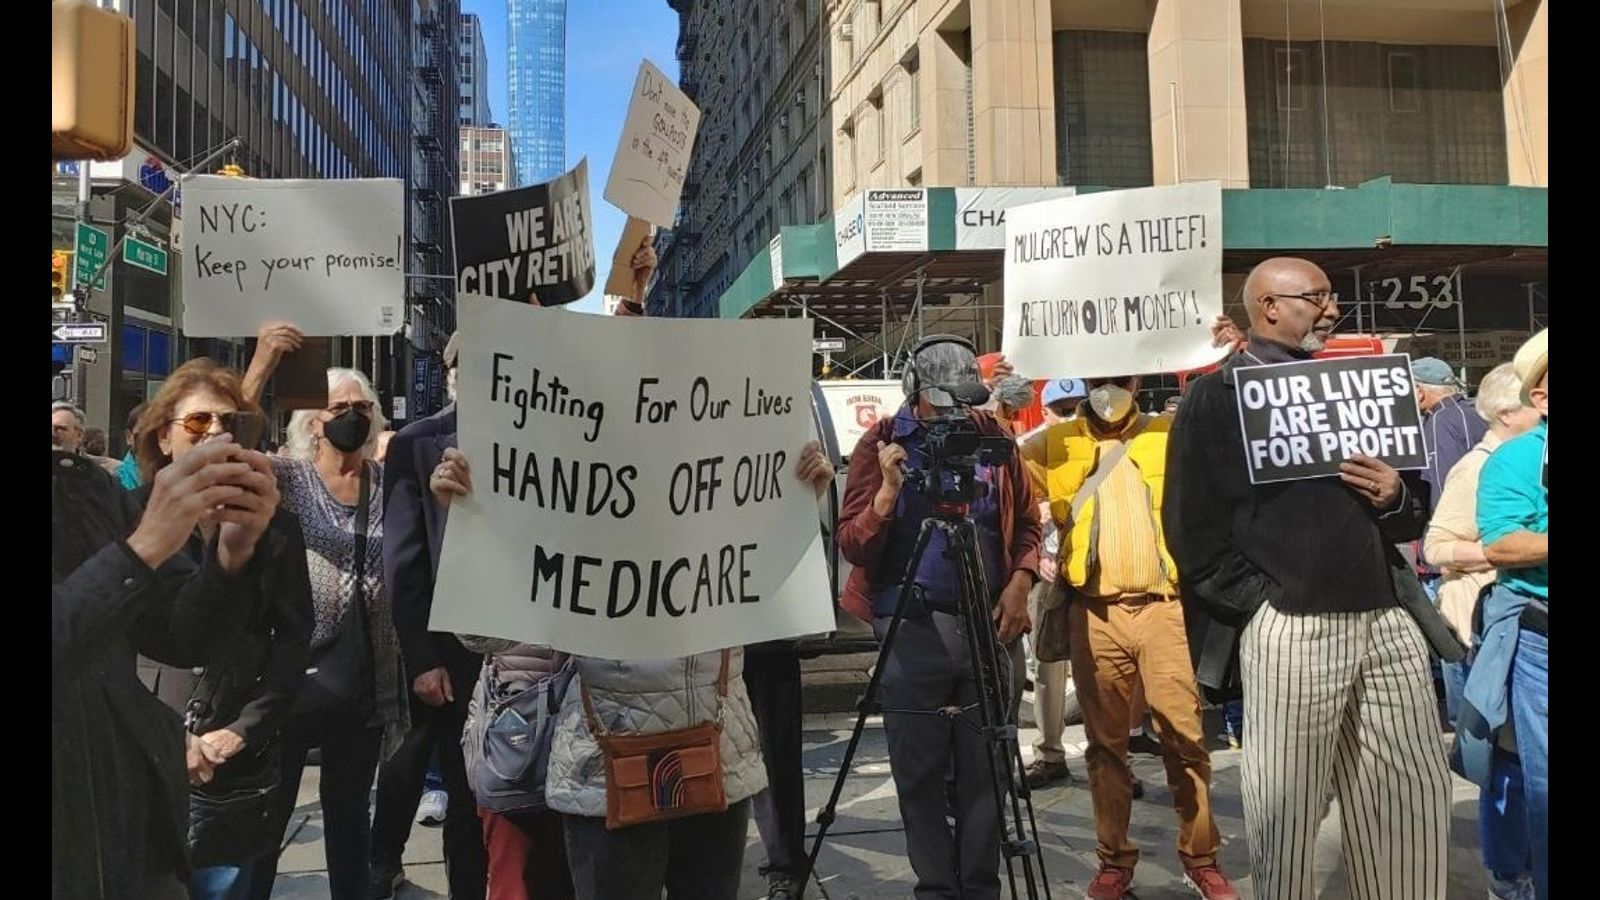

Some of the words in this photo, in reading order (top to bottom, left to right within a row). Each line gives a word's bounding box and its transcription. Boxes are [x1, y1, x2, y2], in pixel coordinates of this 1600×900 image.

[200, 204, 267, 233] NYC:
[505, 207, 545, 253] WE
[552, 191, 583, 244] ARE
[1096, 223, 1113, 256] IS
[1118, 222, 1132, 254] A
[1135, 214, 1206, 253] THIEF!
[196, 245, 247, 292] Keep
[262, 257, 315, 291] your
[326, 235, 401, 277] promise!
[460, 256, 521, 298] CITY
[1381, 276, 1454, 309] 253
[1018, 300, 1079, 337] RETURN
[1081, 296, 1119, 335] OUR
[491, 353, 604, 442] Fighting
[635, 378, 677, 423] For
[690, 376, 731, 421] Our
[743, 377, 793, 418] Lives
[1243, 375, 1315, 409] OUR
[1320, 367, 1410, 402] LIVES
[1269, 403, 1330, 437] ARE
[1337, 397, 1395, 430] NOT
[1251, 436, 1315, 470] FOR
[1319, 426, 1418, 462] PROFIT
[492, 443, 638, 519] HANDS
[669, 456, 724, 515] OFF
[734, 450, 786, 506] OUR
[531, 543, 760, 619] MEDICARE
